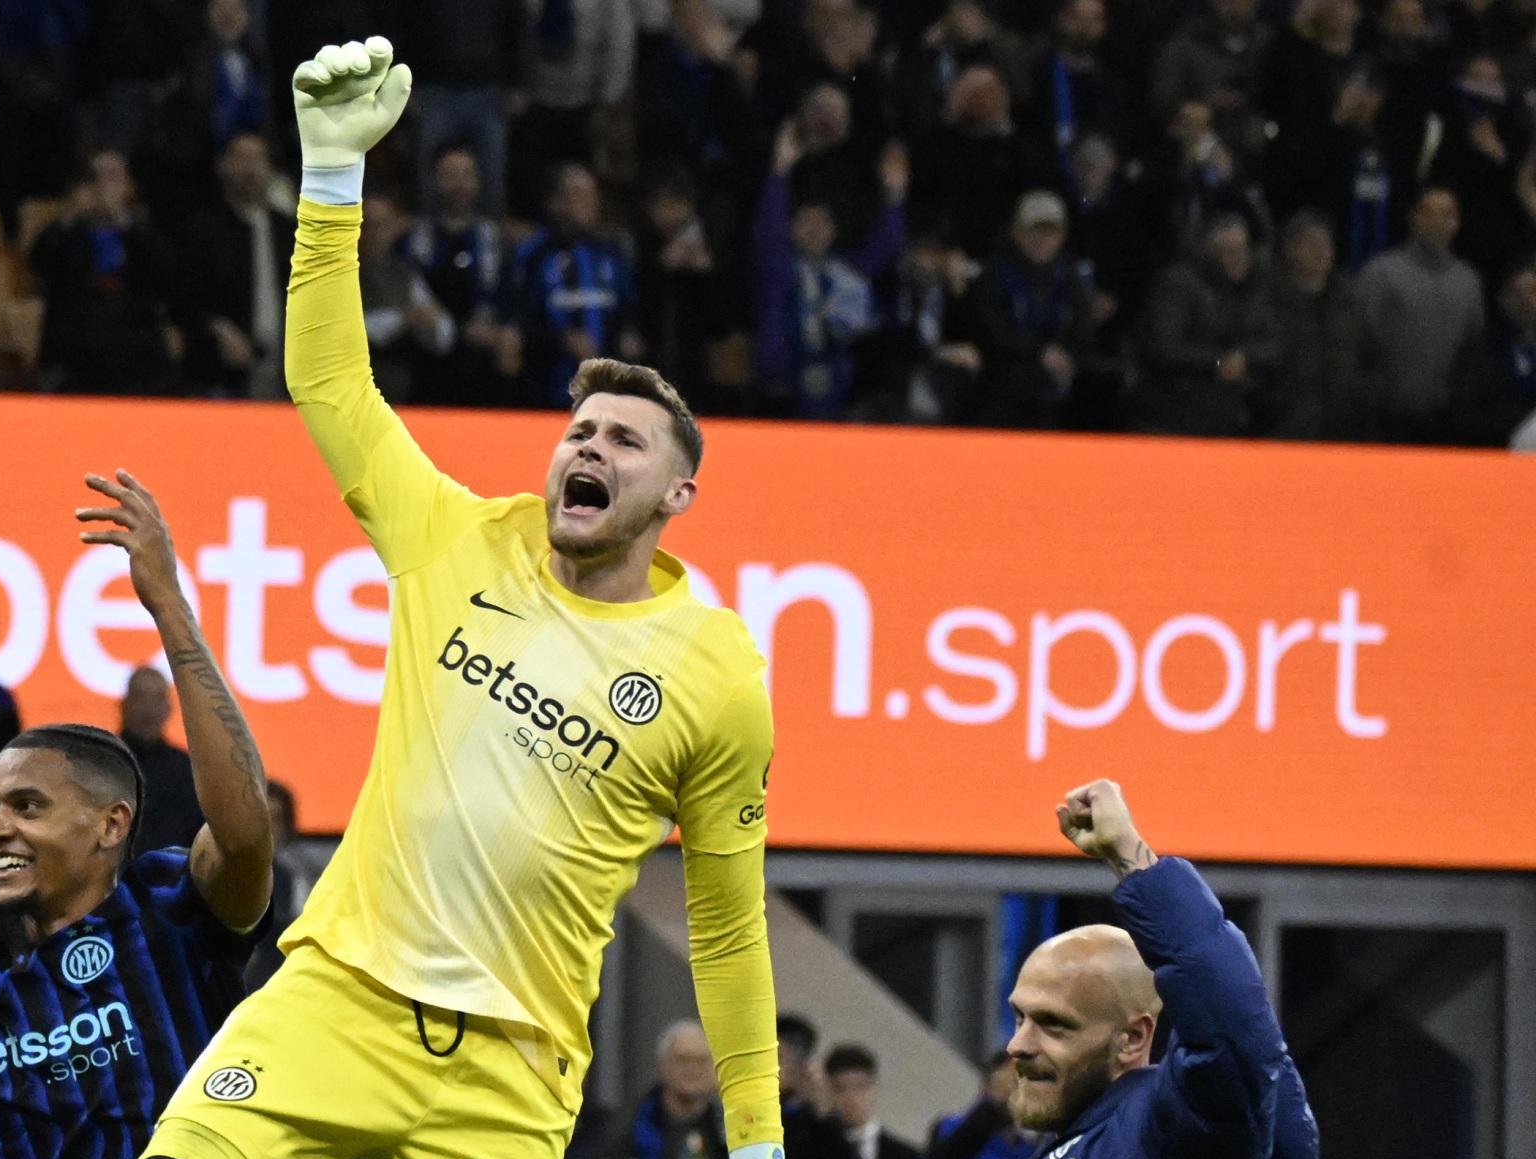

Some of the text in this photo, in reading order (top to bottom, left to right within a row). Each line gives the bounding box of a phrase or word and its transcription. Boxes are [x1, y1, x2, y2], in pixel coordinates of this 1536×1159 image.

[437, 626, 621, 771] betsson
[505, 726, 601, 792] .sport
[46, 1033, 140, 1085] .sport
